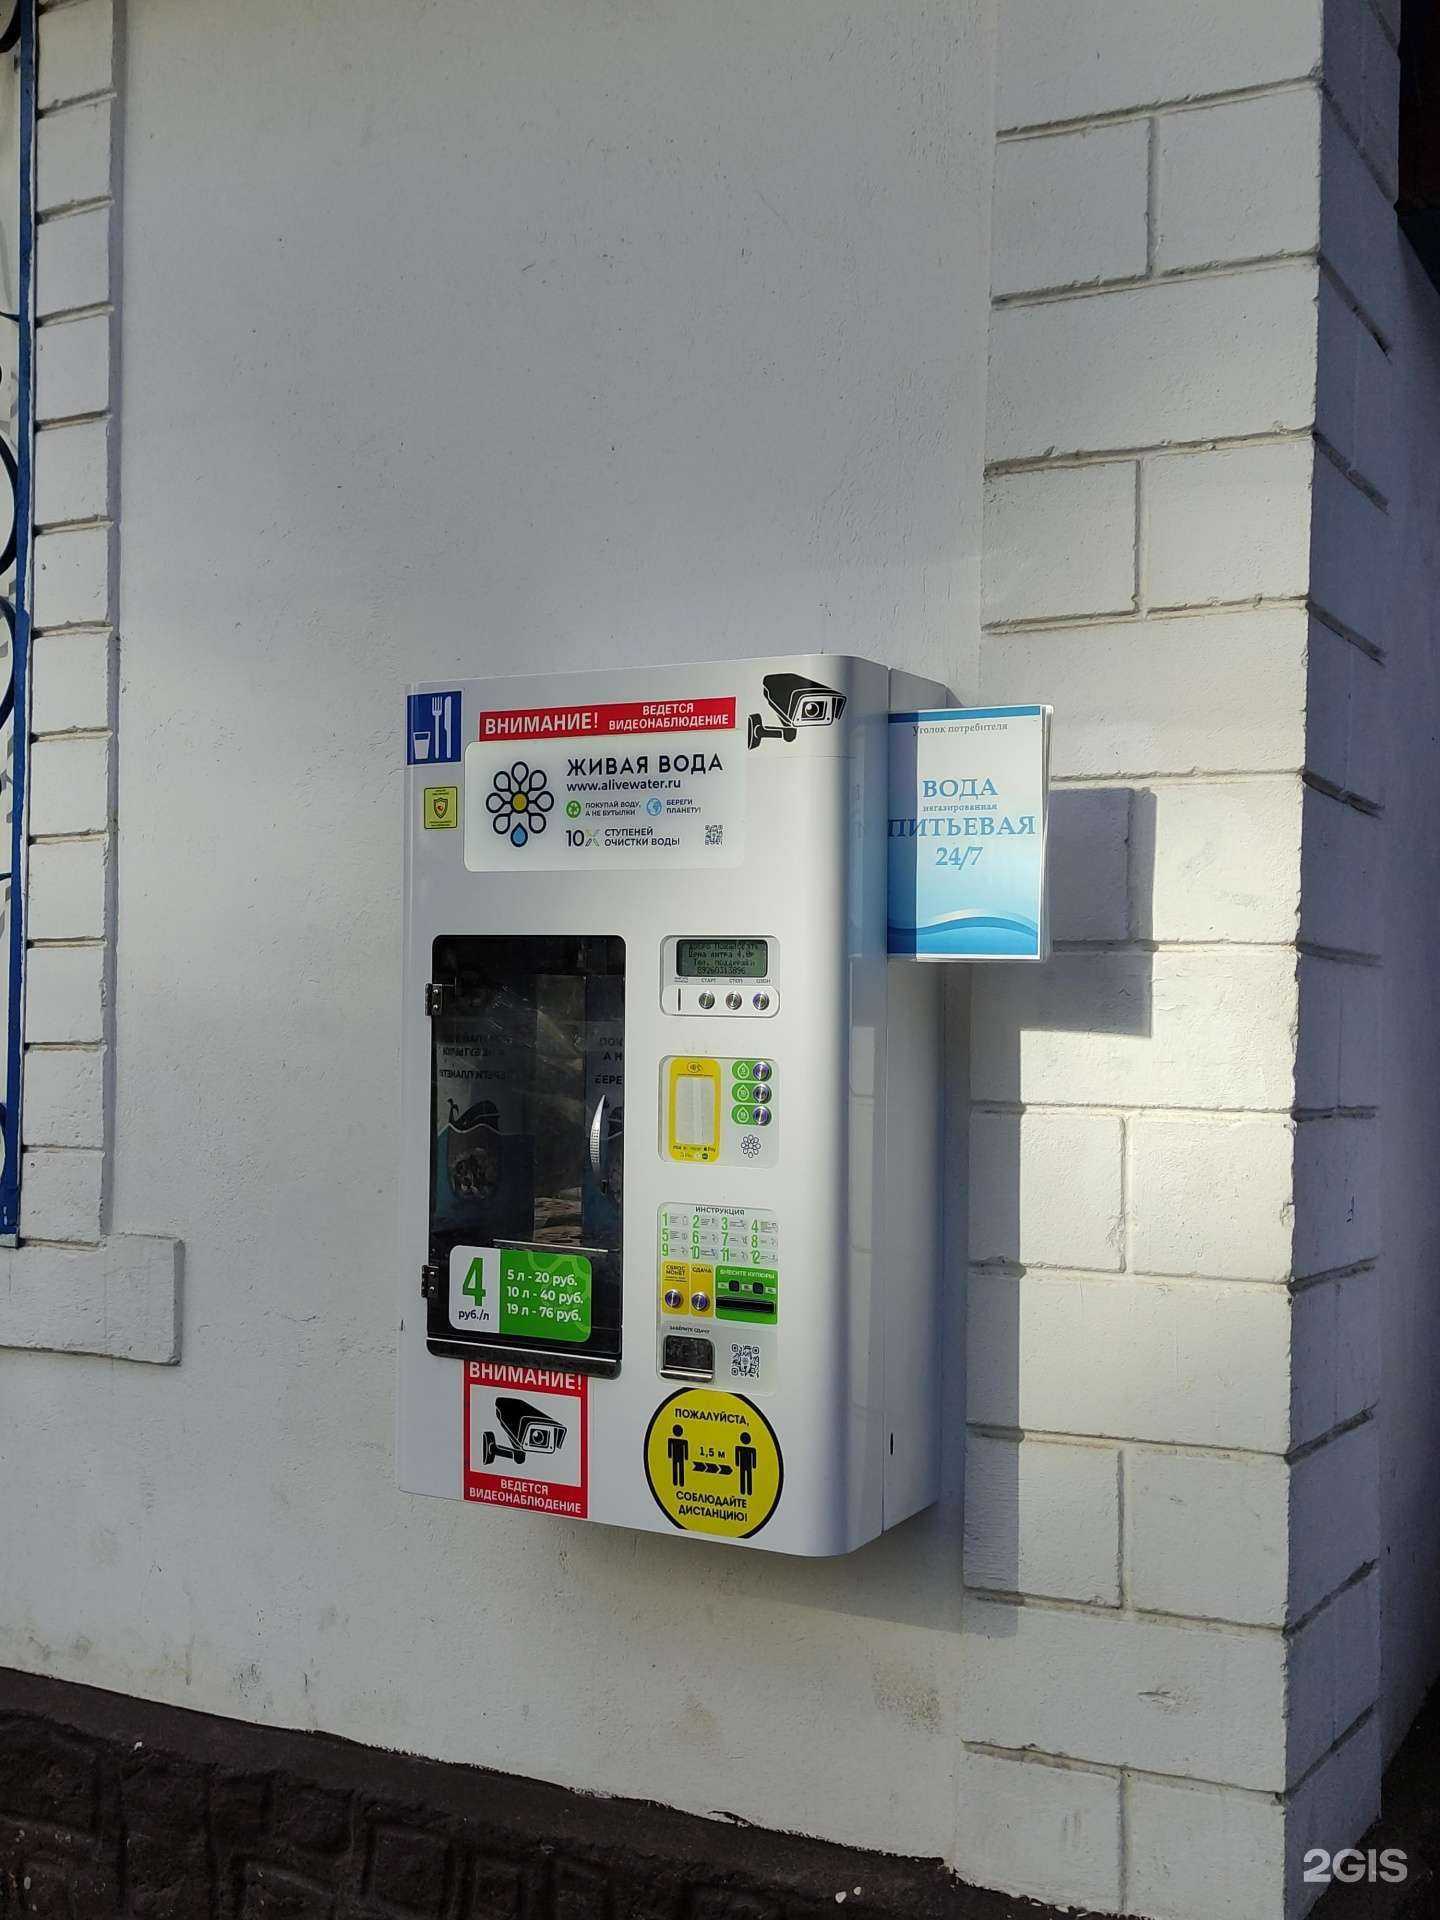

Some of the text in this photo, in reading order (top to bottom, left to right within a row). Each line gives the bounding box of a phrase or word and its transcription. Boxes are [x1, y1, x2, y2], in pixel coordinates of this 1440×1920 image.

[642, 703, 694, 716] ВЕДЕТСЯ
[485, 712, 598, 735] ВНИМАНИЕ!
[609, 714, 729, 732] ВИДЕОНАБЛЮДЕНИЕ
[913, 722, 1008, 737] Уголок потребителя
[567, 753, 723, 776] ЖИВАЯ ВОДА
[566, 778, 681, 792] www.alivewater.ru
[922, 777, 999, 800] ВОДА
[585, 800, 619, 809] ПОКУПАЙ
[923, 802, 998, 814] негазированная
[604, 826, 653, 837] СТУПЕНЕЙ
[888, 815, 1035, 838] ПИТЬЕВАЯ
[604, 837, 680, 847] ОЧИСТКИ ВОДЫ
[935, 846, 984, 870] 24/7
[695, 1206, 745, 1216] ИНСТРУКЦИЯ
[662, 1213, 668, 1226] 1
[692, 1215, 700, 1228] 2
[721, 1216, 728, 1230] 3
[751, 1219, 759, 1233] 4
[662, 1228, 668, 1241] 5
[692, 1231, 700, 1244] 6
[721, 1232, 728, 1246] 7
[751, 1235, 758, 1248] 8
[662, 1243, 668, 1256] 9
[690, 1246, 700, 1259] 10
[720, 1248, 729, 1261] 11
[750, 1250, 760, 1264] 12
[462, 1257, 487, 1307] 4
[507, 1269, 514, 1280] 5
[517, 1272, 525, 1281] л
[534, 1272, 550, 1283] 20
[552, 1274, 577, 1287] руб.
[507, 1286, 519, 1297] 10
[521, 1290, 530, 1299] л
[540, 1289, 556, 1301] 40
[558, 1292, 584, 1305] руб.
[458, 1309, 490, 1321] руб./л
[507, 1303, 519, 1314] 19
[521, 1307, 529, 1316] л
[539, 1307, 554, 1318] 76
[556, 1309, 582, 1322] руб.
[469, 1361, 582, 1391] ВНИМАНИЕ!
[675, 1408, 750, 1427] ПОЖАЛУЙСТА,
[699, 1446, 726, 1458] 1,5 м
[500, 1478, 549, 1496] ВЕДЕТСЯ
[469, 1487, 582, 1514] ВИДЕОНАБЛЮДЕНИЕ
[676, 1490, 747, 1508] СОБЛЮДАЙТЕ
[678, 1504, 748, 1522] ДИСТАНЦИЮ!
